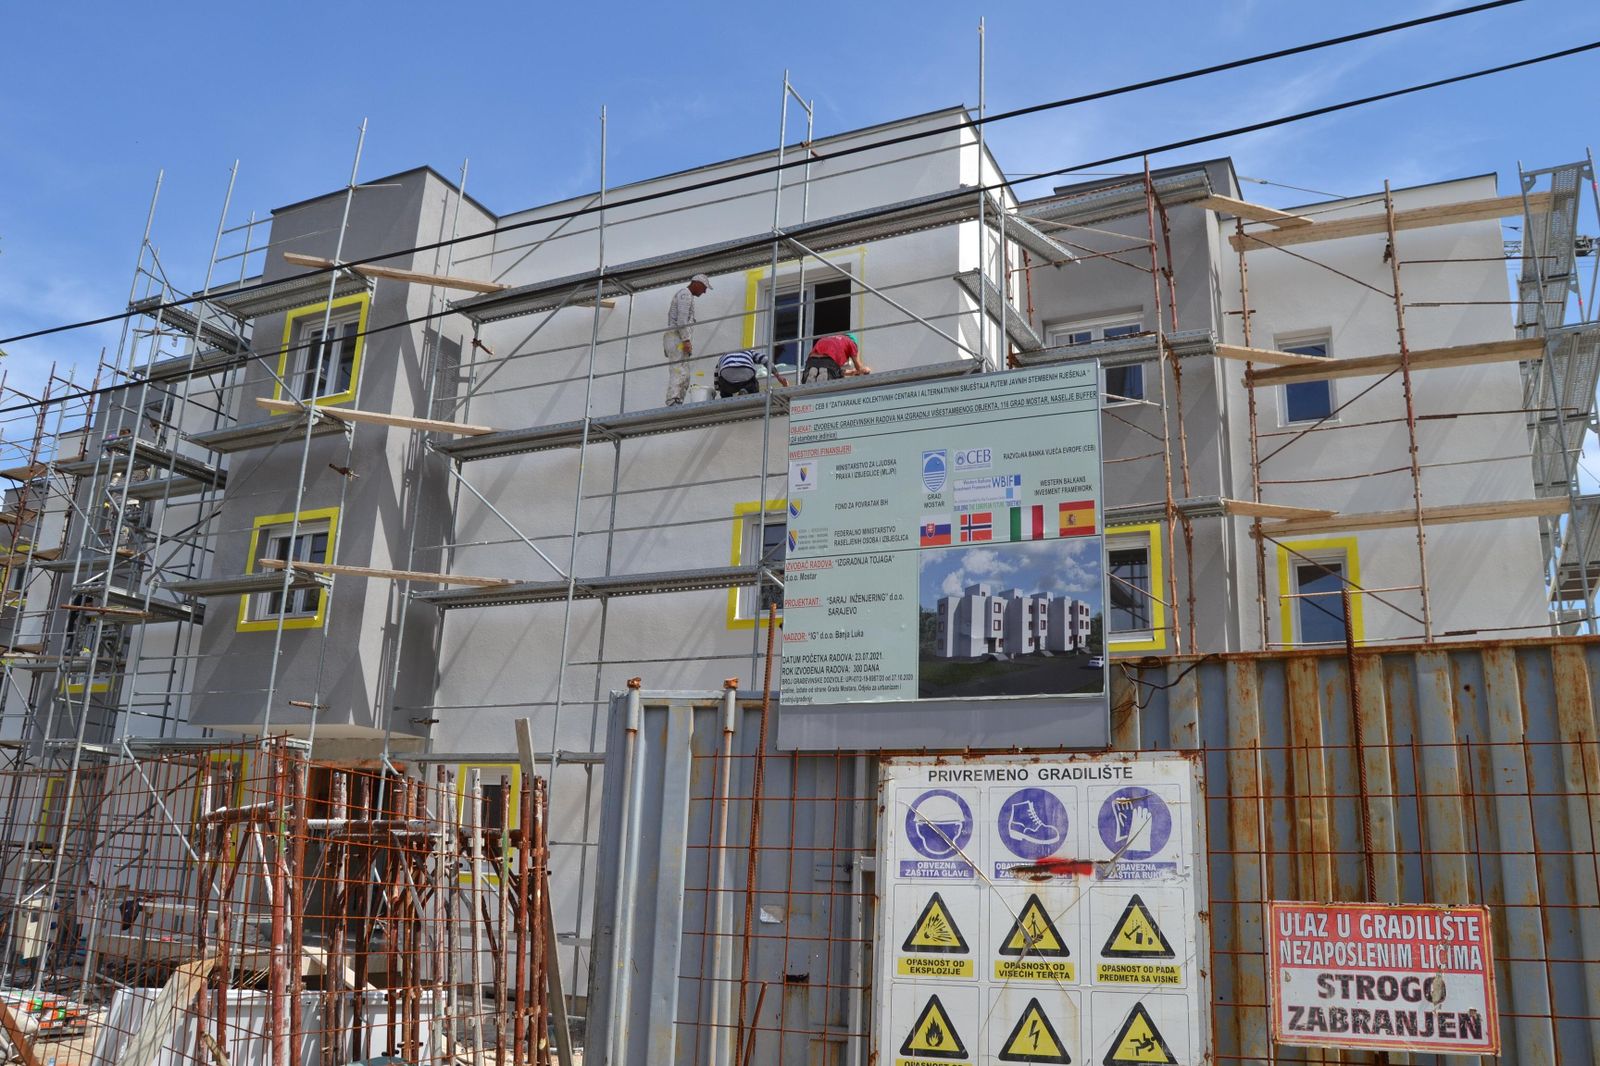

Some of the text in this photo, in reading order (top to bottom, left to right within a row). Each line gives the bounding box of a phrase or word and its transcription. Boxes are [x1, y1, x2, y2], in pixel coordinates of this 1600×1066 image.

[862, 395, 893, 405] KOLEKTIVNIH
[894, 391, 917, 401] CENTARA
[921, 386, 959, 397] ALTERNATIVNIH
[990, 379, 1008, 388] PUTEM
[875, 414, 895, 423] RADOVA
[904, 410, 930, 420] IZGRADNJI
[1010, 399, 1025, 408] GRAD
[1050, 392, 1074, 403] NASELJE
[1075, 390, 1097, 400] BUFFER
[966, 449, 991, 464] CEB
[1028, 450, 1045, 458] BANKA
[1063, 445, 1082, 454] EVROPE
[836, 461, 868, 471] MINISTARSTVO
[992, 475, 1014, 488] WBIF
[1040, 476, 1086, 487] WESTERN BALKANS
[1061, 484, 1093, 494] FRAMEWORK
[927, 493, 942, 501] GRAD
[834, 502, 847, 511] FOND
[855, 499, 879, 508] POVRATAK
[834, 526, 896, 537] FEDERALNO MINISTARSTVO
[863, 536, 879, 544] OSOBA
[882, 534, 909, 543] IZBJEGLICA
[799, 572, 817, 581] Mostar
[828, 606, 858, 616] SARAJEVO
[835, 630, 850, 641] Banja
[851, 629, 864, 638] Luka
[782, 655, 801, 664] DATUM
[802, 653, 828, 664] POČETKA
[782, 667, 794, 676] ROK
[863, 663, 880, 673] DANA
[928, 764, 1133, 783] PRIVREMENO GRADILIŠTE
[917, 862, 956, 870] OBVEZNA
[1115, 863, 1156, 871] OBAVEZNA
[941, 869, 969, 878] GLAVE
[1280, 911, 1480, 941] ULAZ U GRADILIŠTE
[1280, 940, 1483, 971] NEZAPOSLENIM LICIMA
[906, 958, 965, 969] OPASNOST OD
[1003, 961, 1065, 971] OPASNOST OD
[910, 966, 961, 976] EKSPLOZIJE
[1036, 970, 1070, 980] TERETA
[1101, 965, 1175, 975] OPASNOST OD PADA
[1099, 974, 1178, 984] PREDMETA SA VISINE
[1317, 972, 1447, 1004] STROGO
[1287, 1005, 1483, 1040] ZABRANJEN
